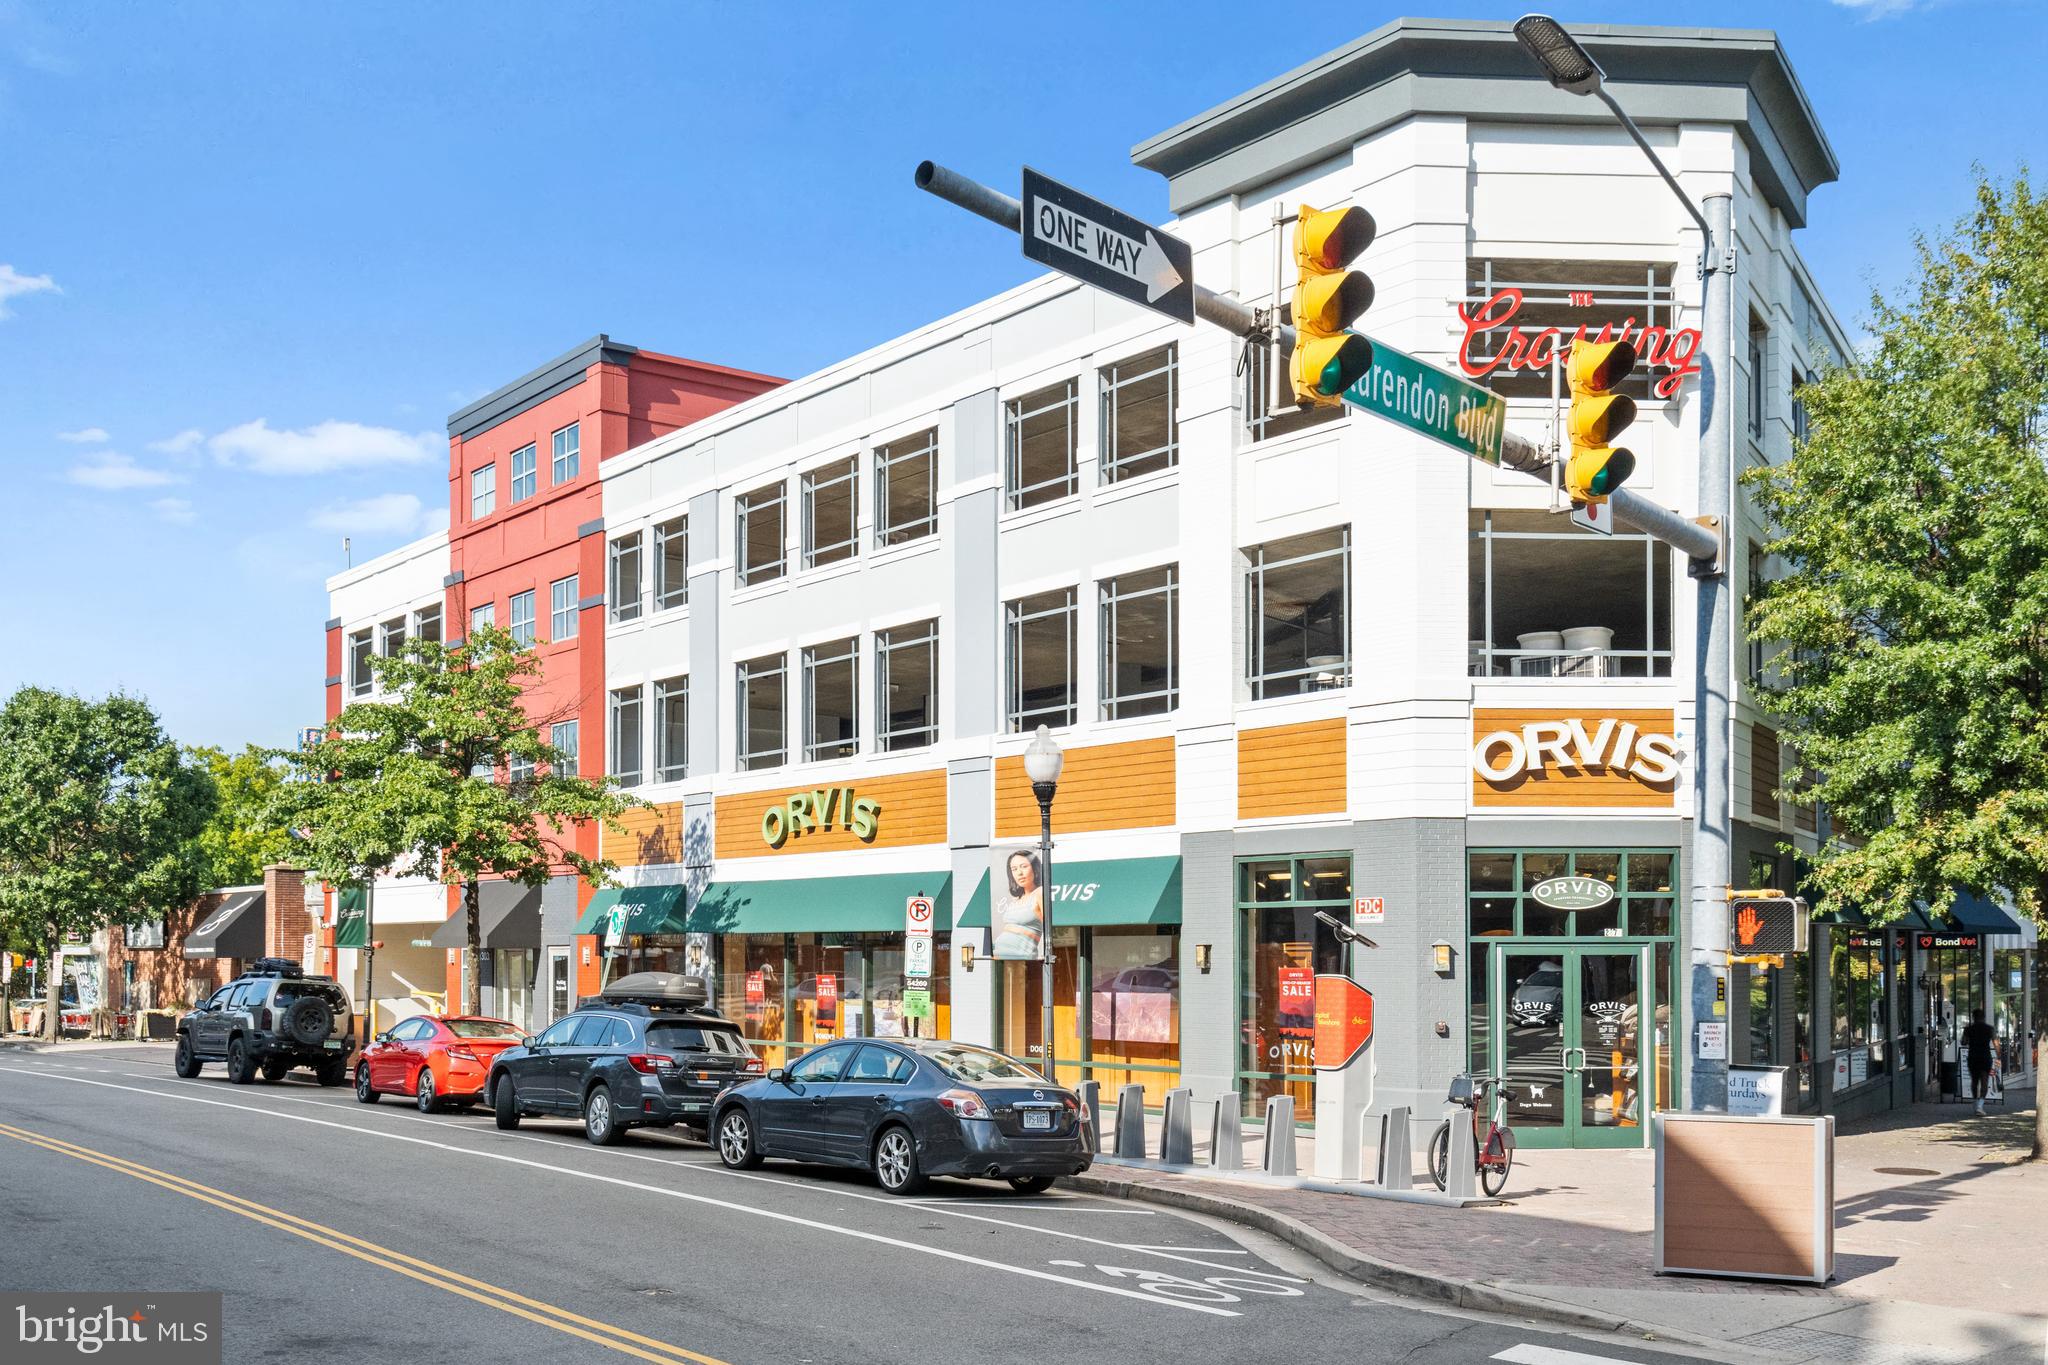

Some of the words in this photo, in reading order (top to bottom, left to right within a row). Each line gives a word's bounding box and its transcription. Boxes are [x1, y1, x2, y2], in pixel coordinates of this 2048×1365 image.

[1040, 204, 1088, 254] ONE
[1096, 228, 1142, 276] WAY
[1569, 291, 1593, 306] THE
[1351, 363, 1450, 432] arendon
[1457, 395, 1498, 453] Blvd
[1473, 717, 1684, 782] ORVIS
[762, 787, 881, 845] ORVIS
[1051, 883, 1097, 902] RVIS
[1537, 881, 1610, 898] ORVIS
[606, 903, 647, 918] OVIS
[1358, 900, 1381, 913] FDC
[747, 983, 763, 992] SALE
[818, 988, 835, 997] SALE
[1282, 985, 1311, 996] SALE
[1514, 1001, 1553, 1012] ORVIS
[1589, 1001, 1628, 1012] ORVIS
[1269, 1042, 1315, 1060] ORVIS
[1730, 1088, 1767, 1102] urdays
